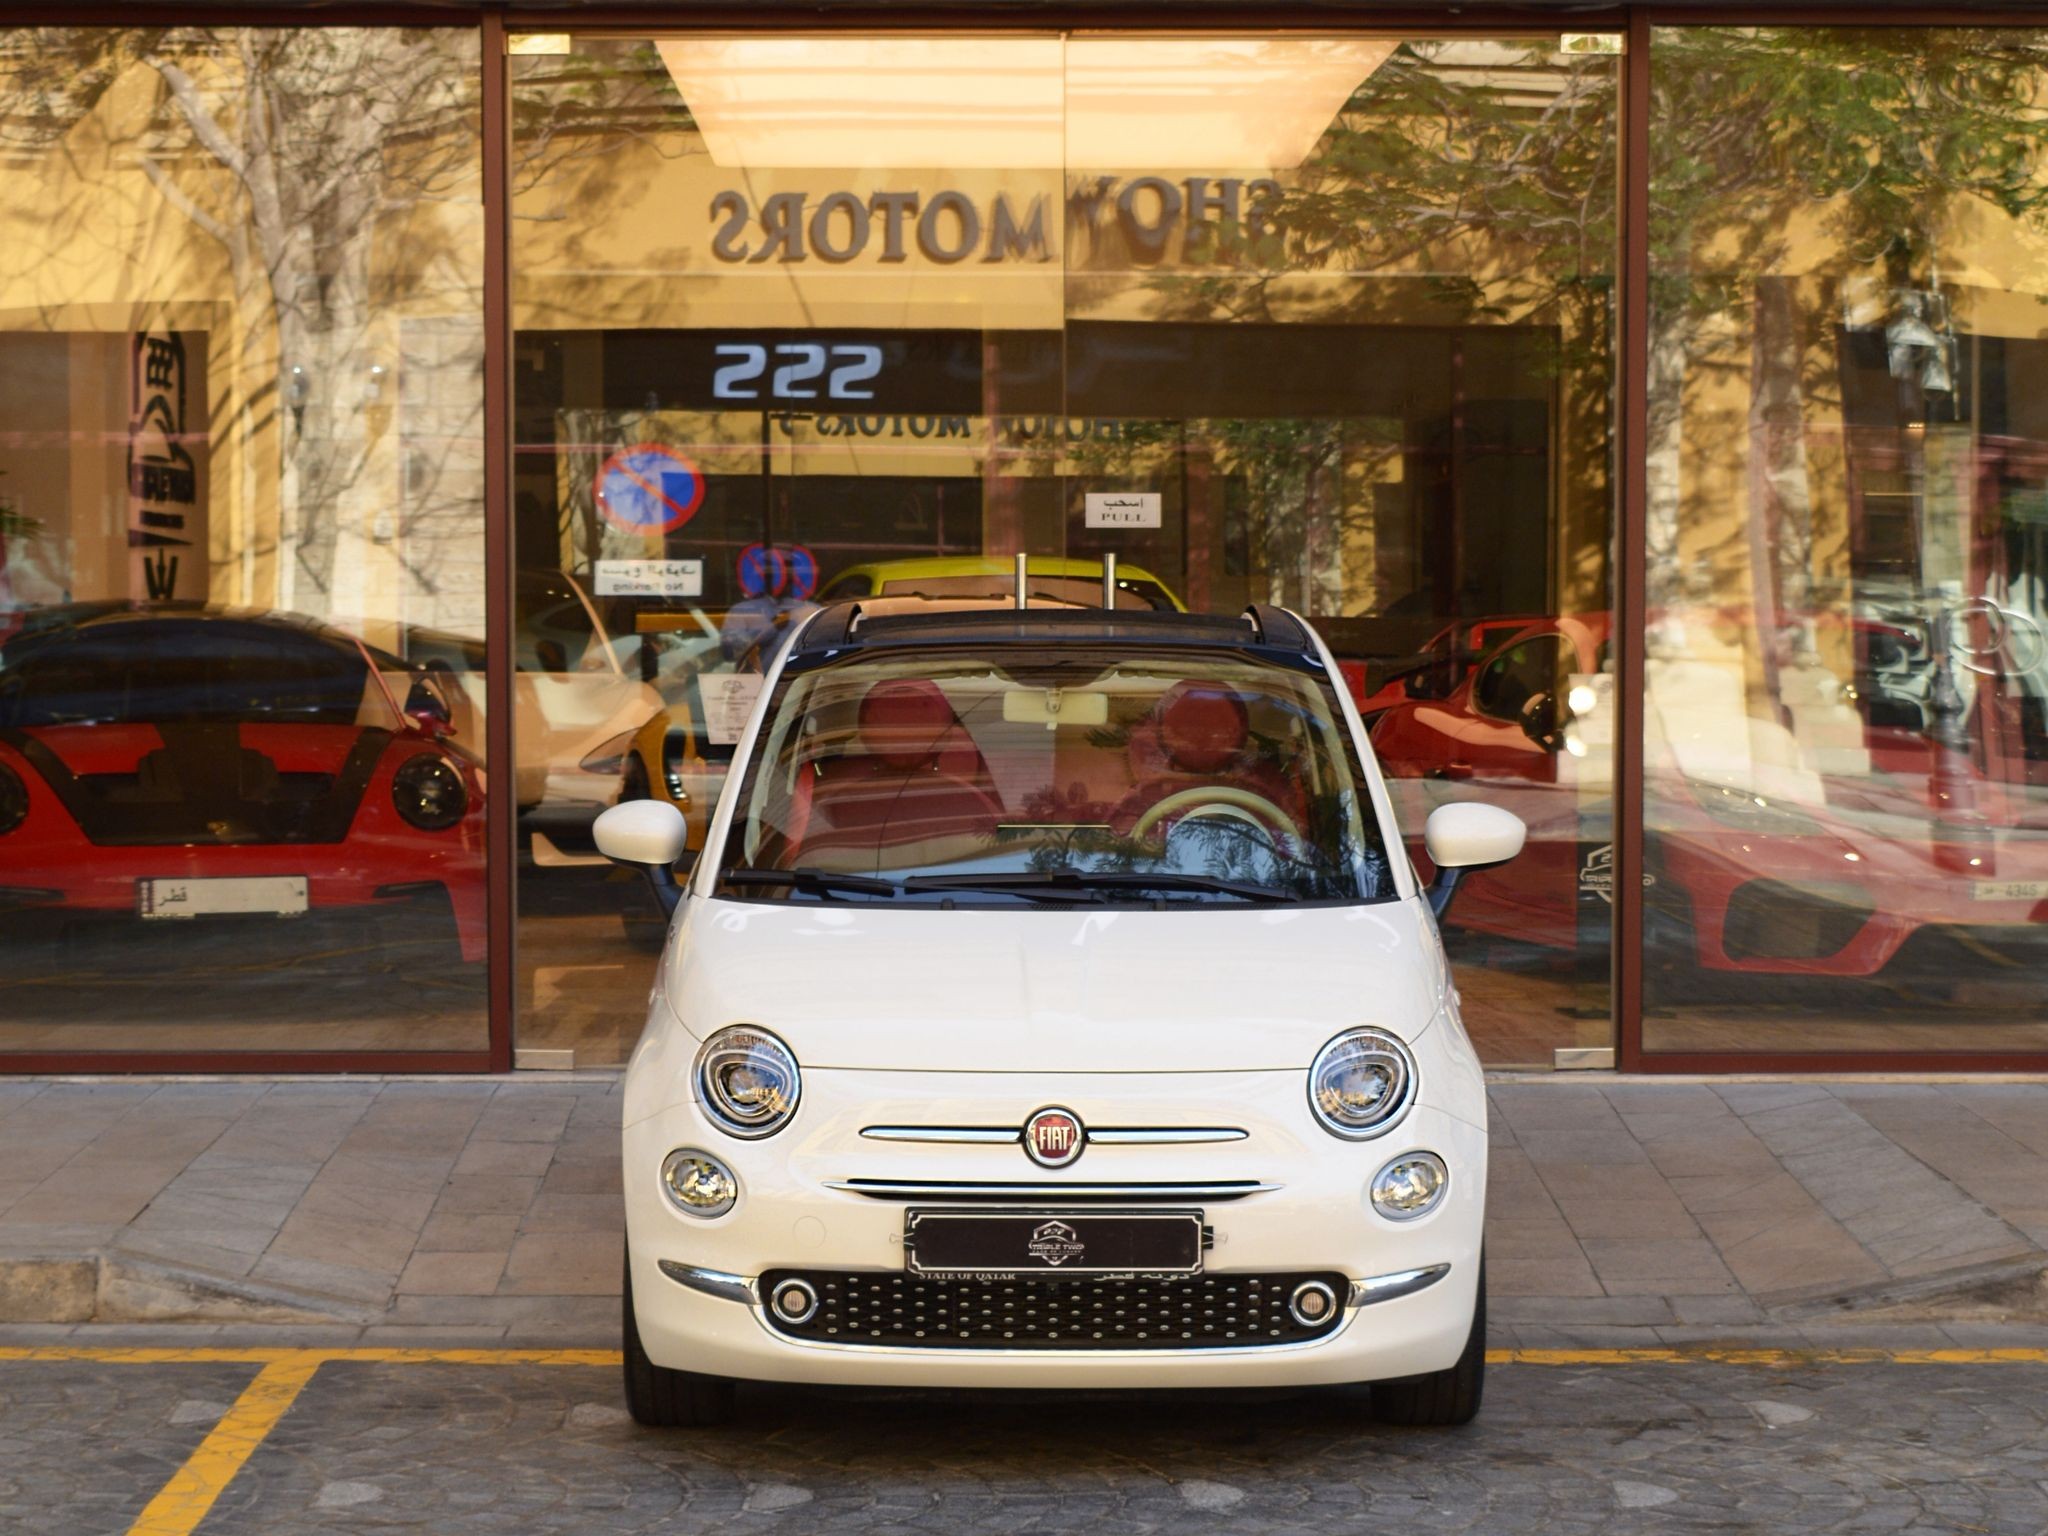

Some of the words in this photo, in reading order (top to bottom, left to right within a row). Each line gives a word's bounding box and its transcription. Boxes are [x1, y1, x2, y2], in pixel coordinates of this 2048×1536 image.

[713, 344, 883, 399] 222
[1102, 512, 1146, 522] PULL
[1039, 1126, 1070, 1150] FIAT
[919, 1272, 955, 1280] STATE
[957, 1272, 973, 1280] OF
[975, 1272, 1016, 1281] QATAR
